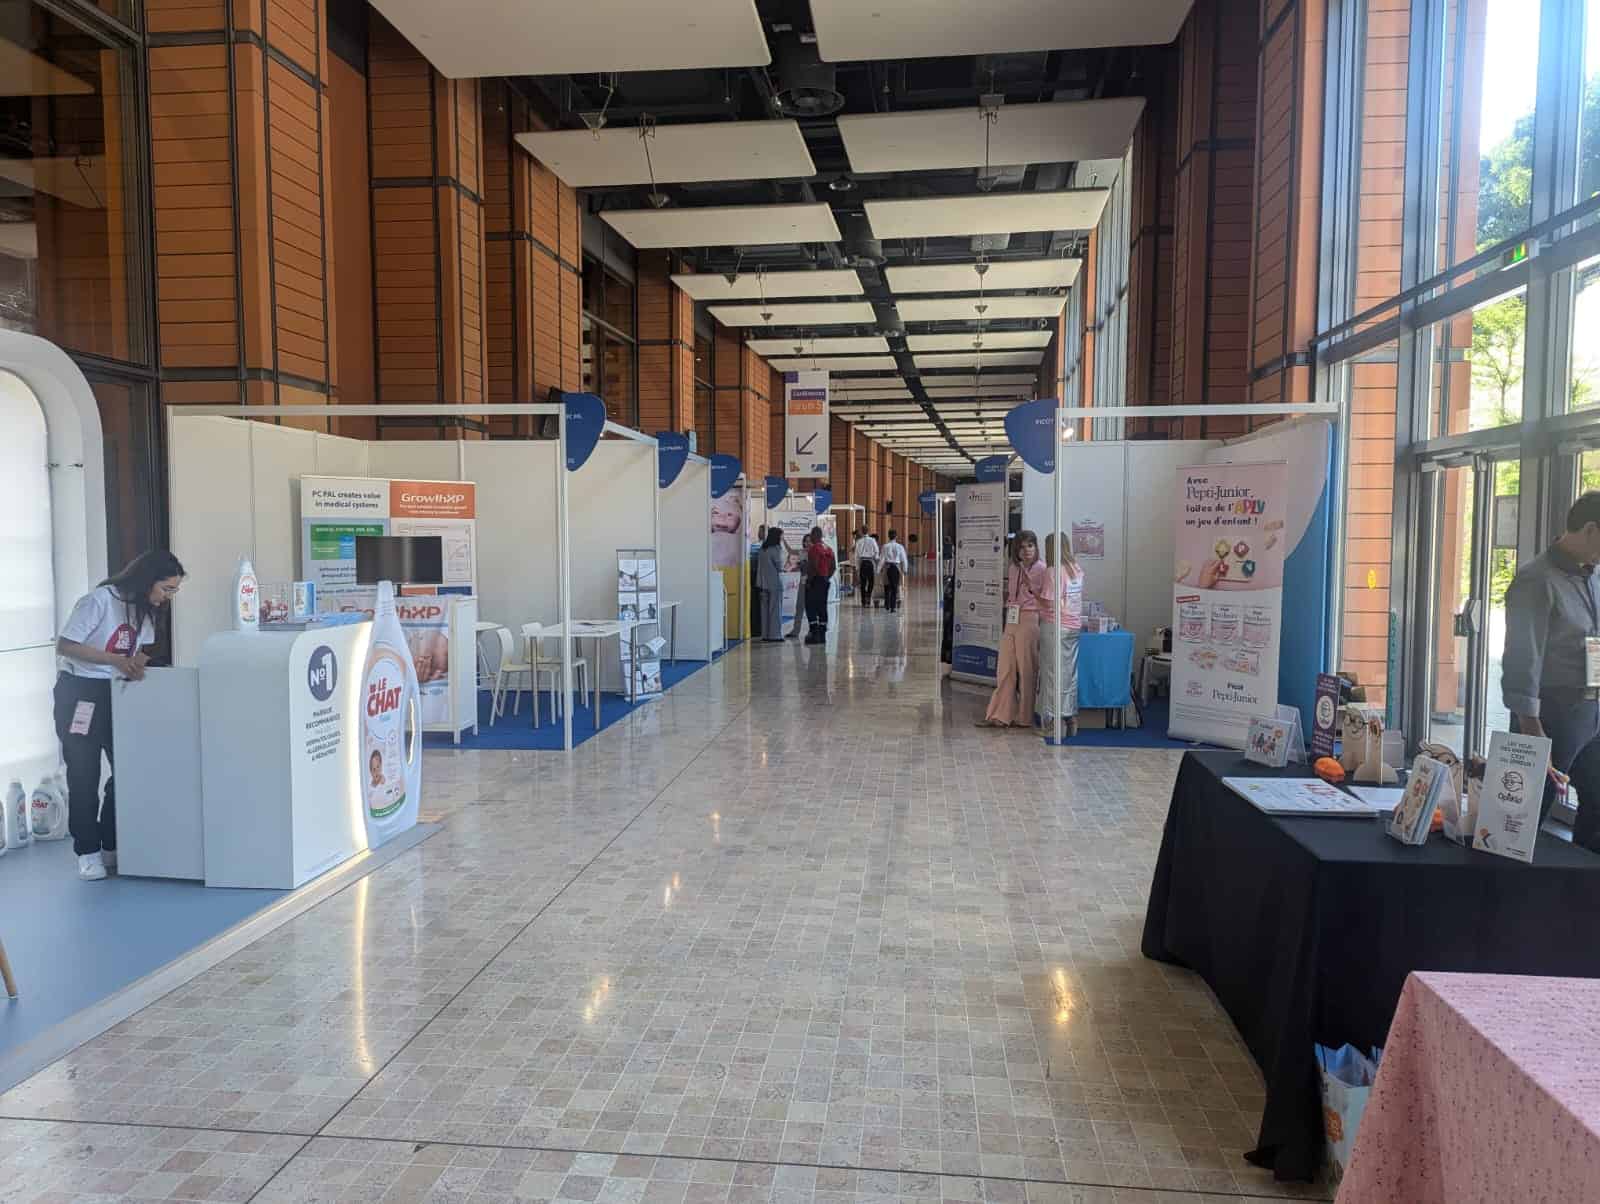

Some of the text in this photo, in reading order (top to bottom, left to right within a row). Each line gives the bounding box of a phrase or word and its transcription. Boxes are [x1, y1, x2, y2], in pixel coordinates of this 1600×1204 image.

[1187, 476, 1208, 484] Avec
[323, 490, 337, 498] PAL
[338, 491, 362, 499] creates
[400, 493, 465, 503] GrowthXP
[1216, 503, 1225, 512] de
[378, 677, 387, 691] LE
[367, 686, 402, 716] CHAT
